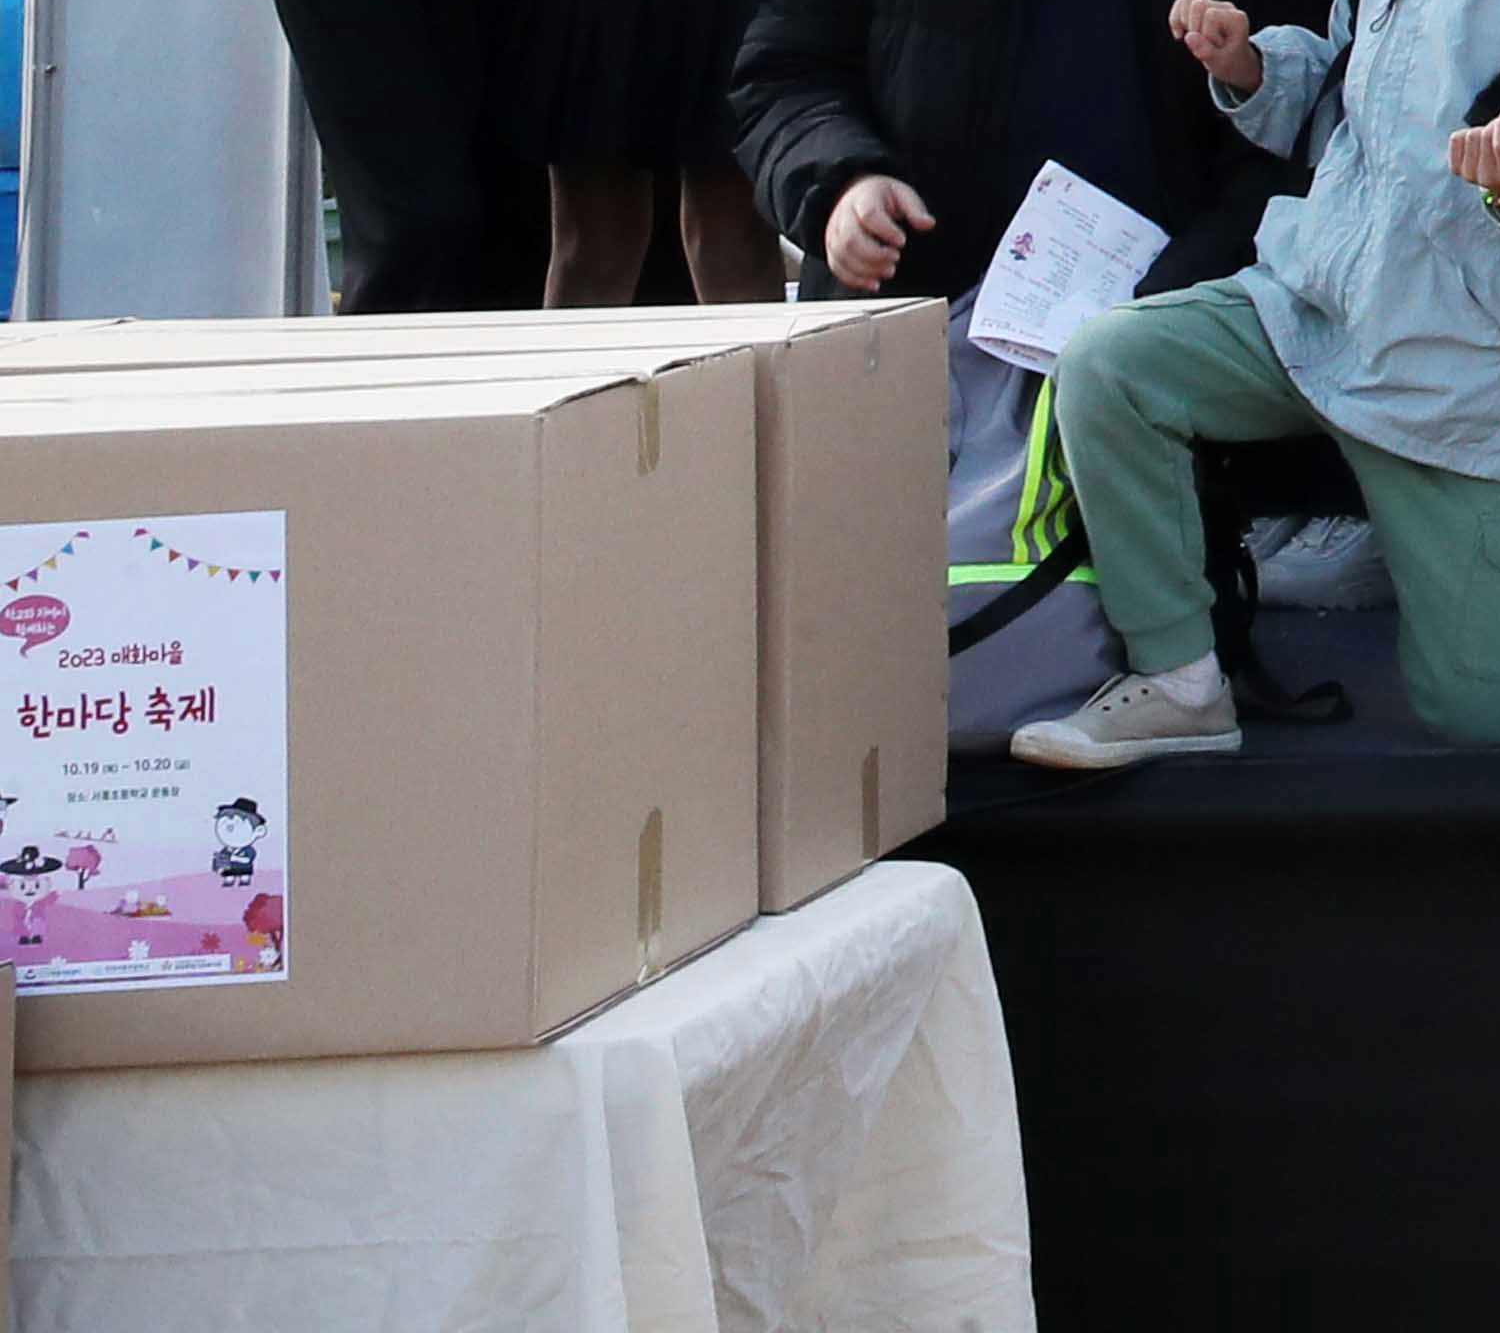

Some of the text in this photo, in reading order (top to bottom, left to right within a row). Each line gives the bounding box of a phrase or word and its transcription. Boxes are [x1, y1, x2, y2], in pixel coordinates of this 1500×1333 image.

[58, 640, 183, 668] 2023 매화마을
[18, 685, 216, 739] 한마당 축제
[62, 762, 99, 776] 10.19
[133, 758, 172, 772] 10.20
